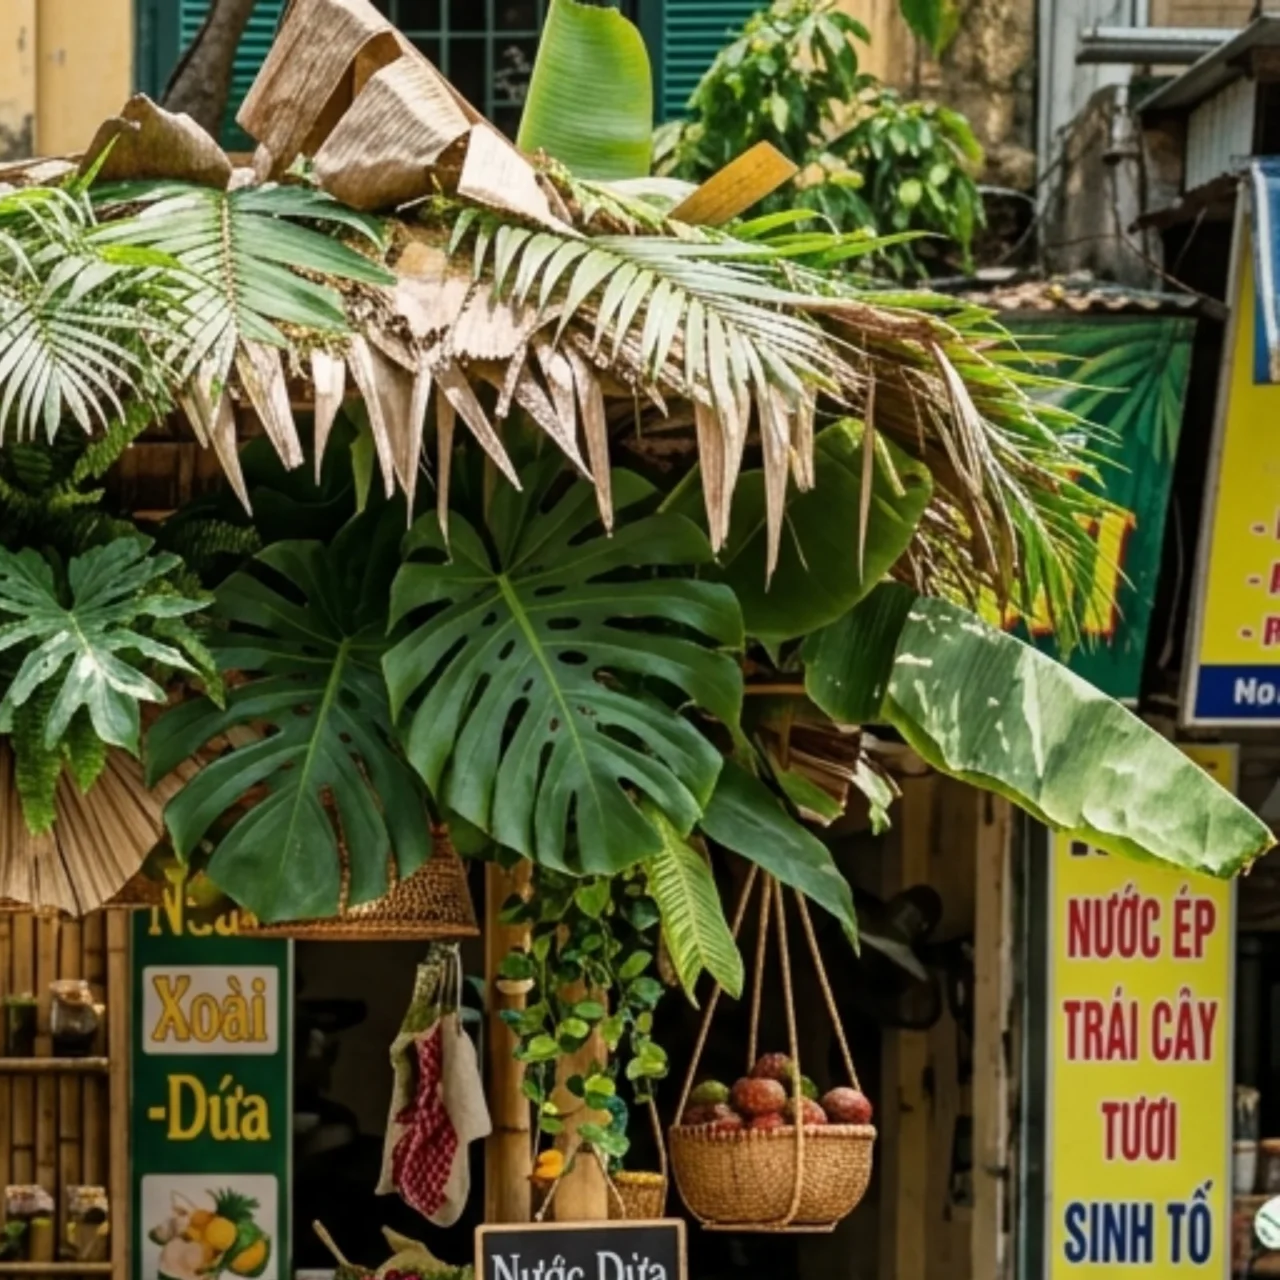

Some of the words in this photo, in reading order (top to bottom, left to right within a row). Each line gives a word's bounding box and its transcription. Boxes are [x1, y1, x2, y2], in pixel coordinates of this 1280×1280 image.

[1066, 882, 1161, 959] NƯỚC
[1172, 884, 1216, 959] ÉP
[151, 974, 267, 1042] Xoài
[1064, 986, 1139, 1061] TRÁI
[1151, 987, 1218, 1061] CÂY
[1101, 1096, 1178, 1162] TƯƠI
[1064, 1202, 1154, 1264] SINH
[1167, 1179, 1214, 1265] TỐ
